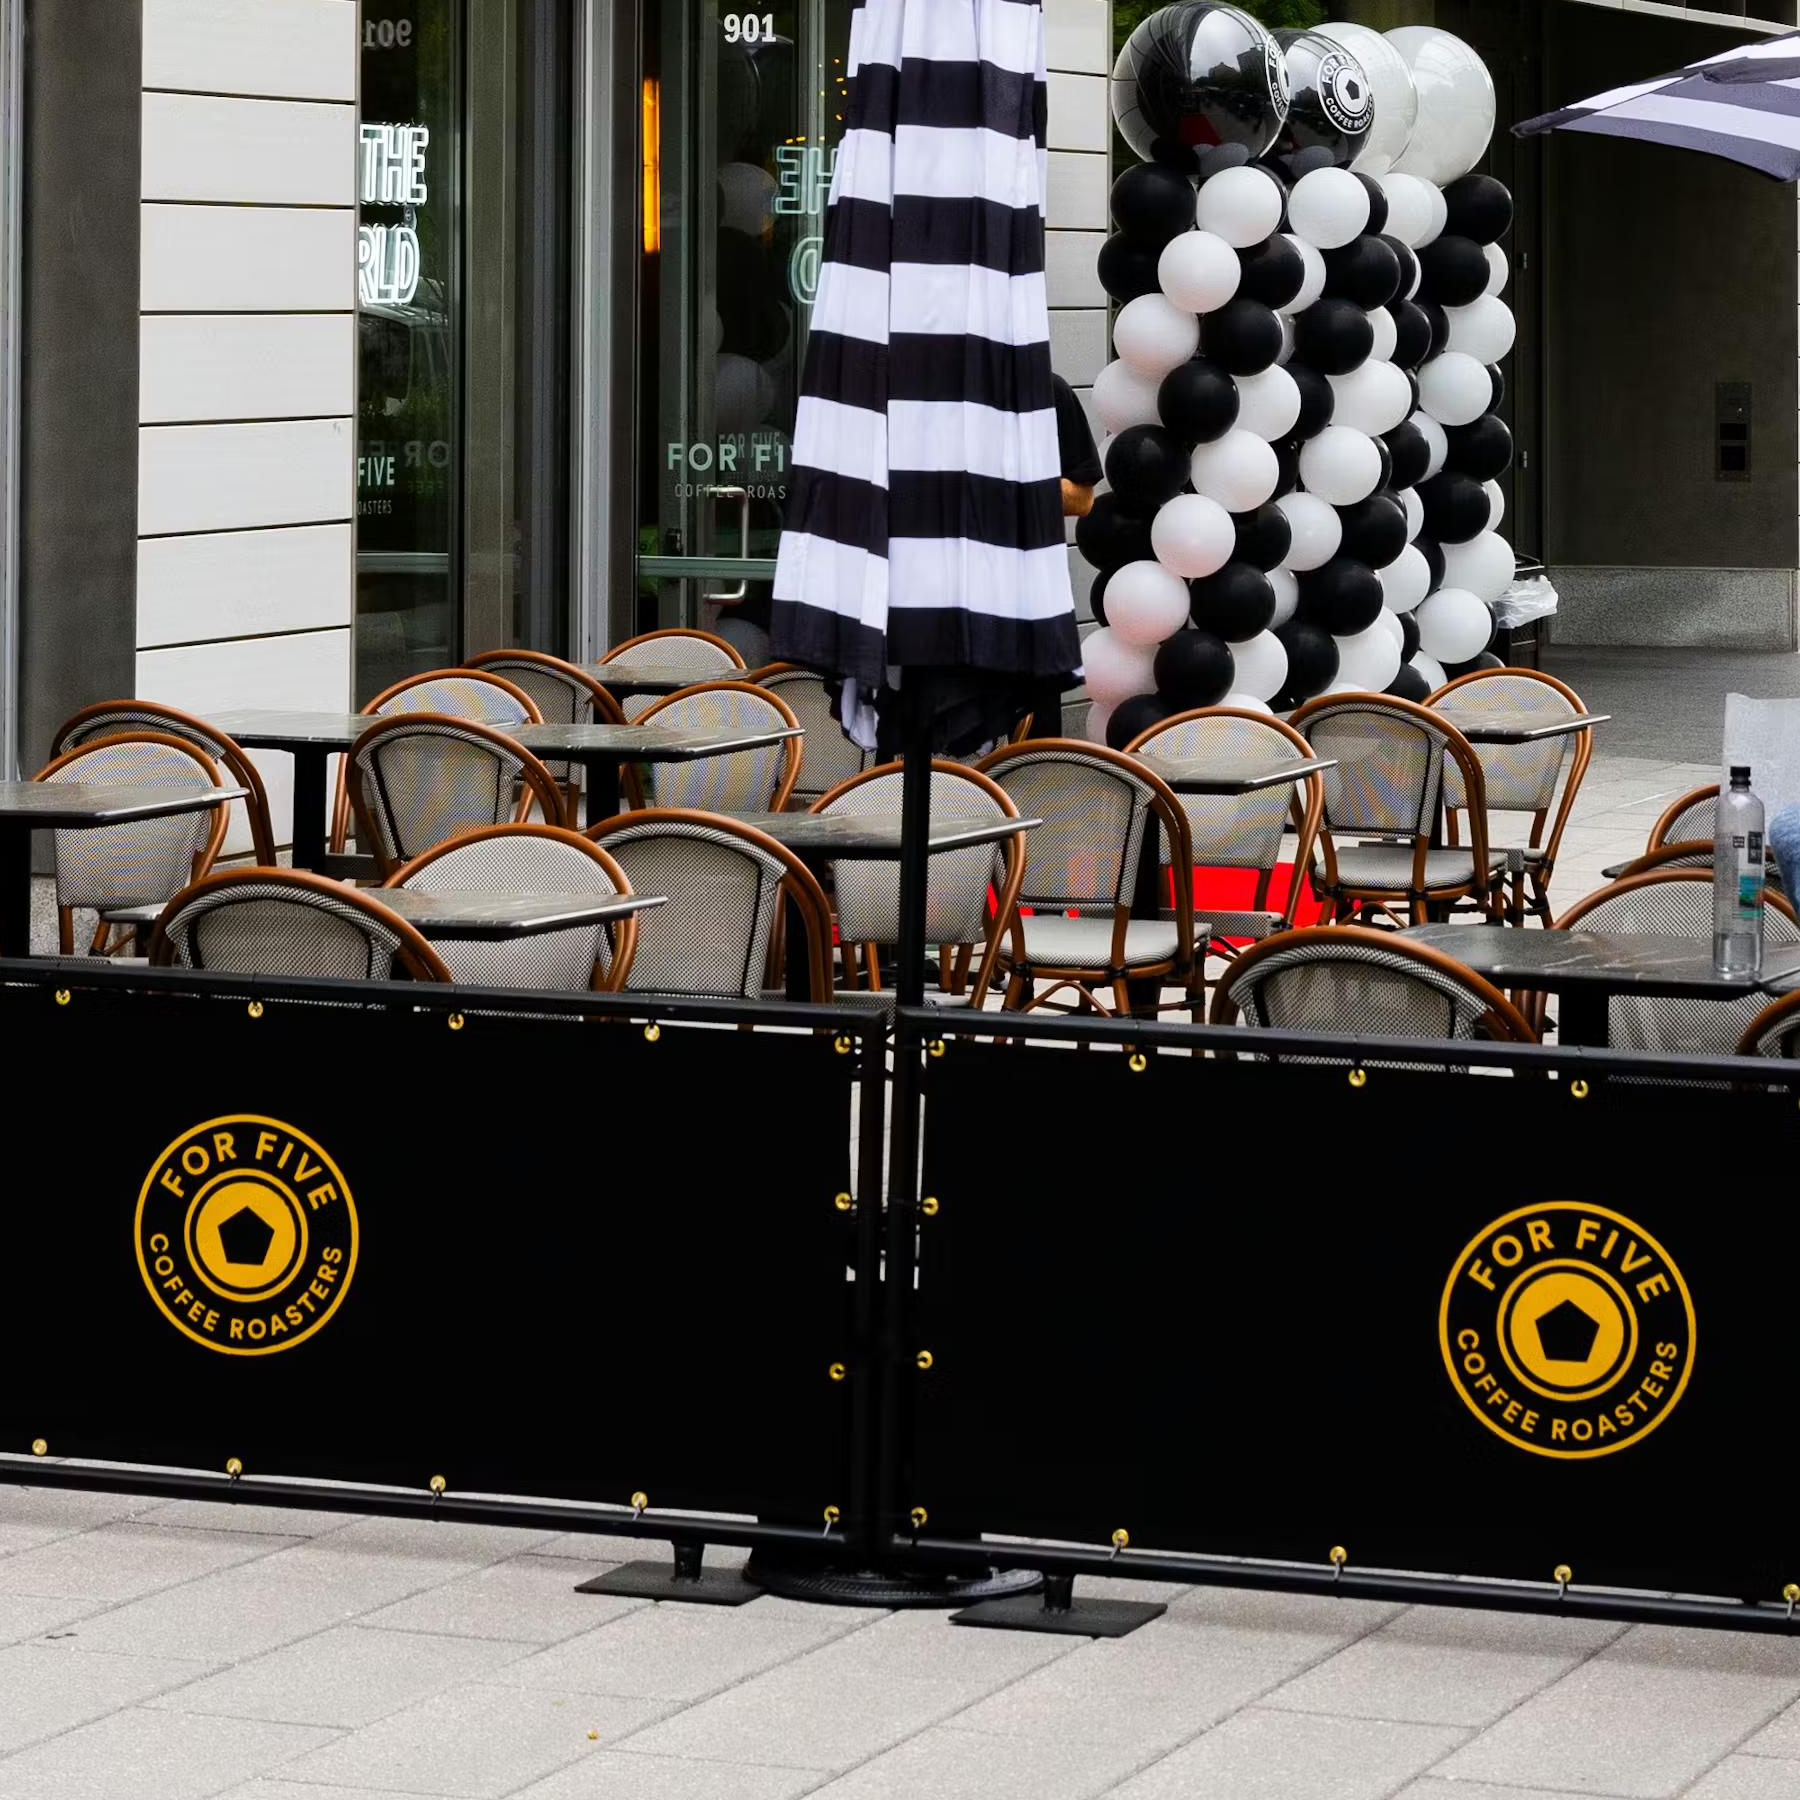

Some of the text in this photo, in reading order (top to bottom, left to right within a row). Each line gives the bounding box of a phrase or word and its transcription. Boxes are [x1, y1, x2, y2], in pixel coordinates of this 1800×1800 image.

[724, 13, 777, 43] 901
[1326, 97, 1352, 127] COFFEE
[360, 124, 429, 204] THE
[359, 226, 420, 304] RLD
[358, 457, 395, 486] FIVE
[668, 443, 788, 472] FOR FI
[358, 500, 392, 515] OASTERS
[675, 484, 787, 499] COFFEE ROAS
[160, 1131, 338, 1210] FOR FIVE
[150, 1233, 342, 1340] COFFEE ROASTERS
[1468, 1218, 1671, 1303] FOR FIVE
[1458, 1328, 1677, 1442] COFFEE ROASTERS
